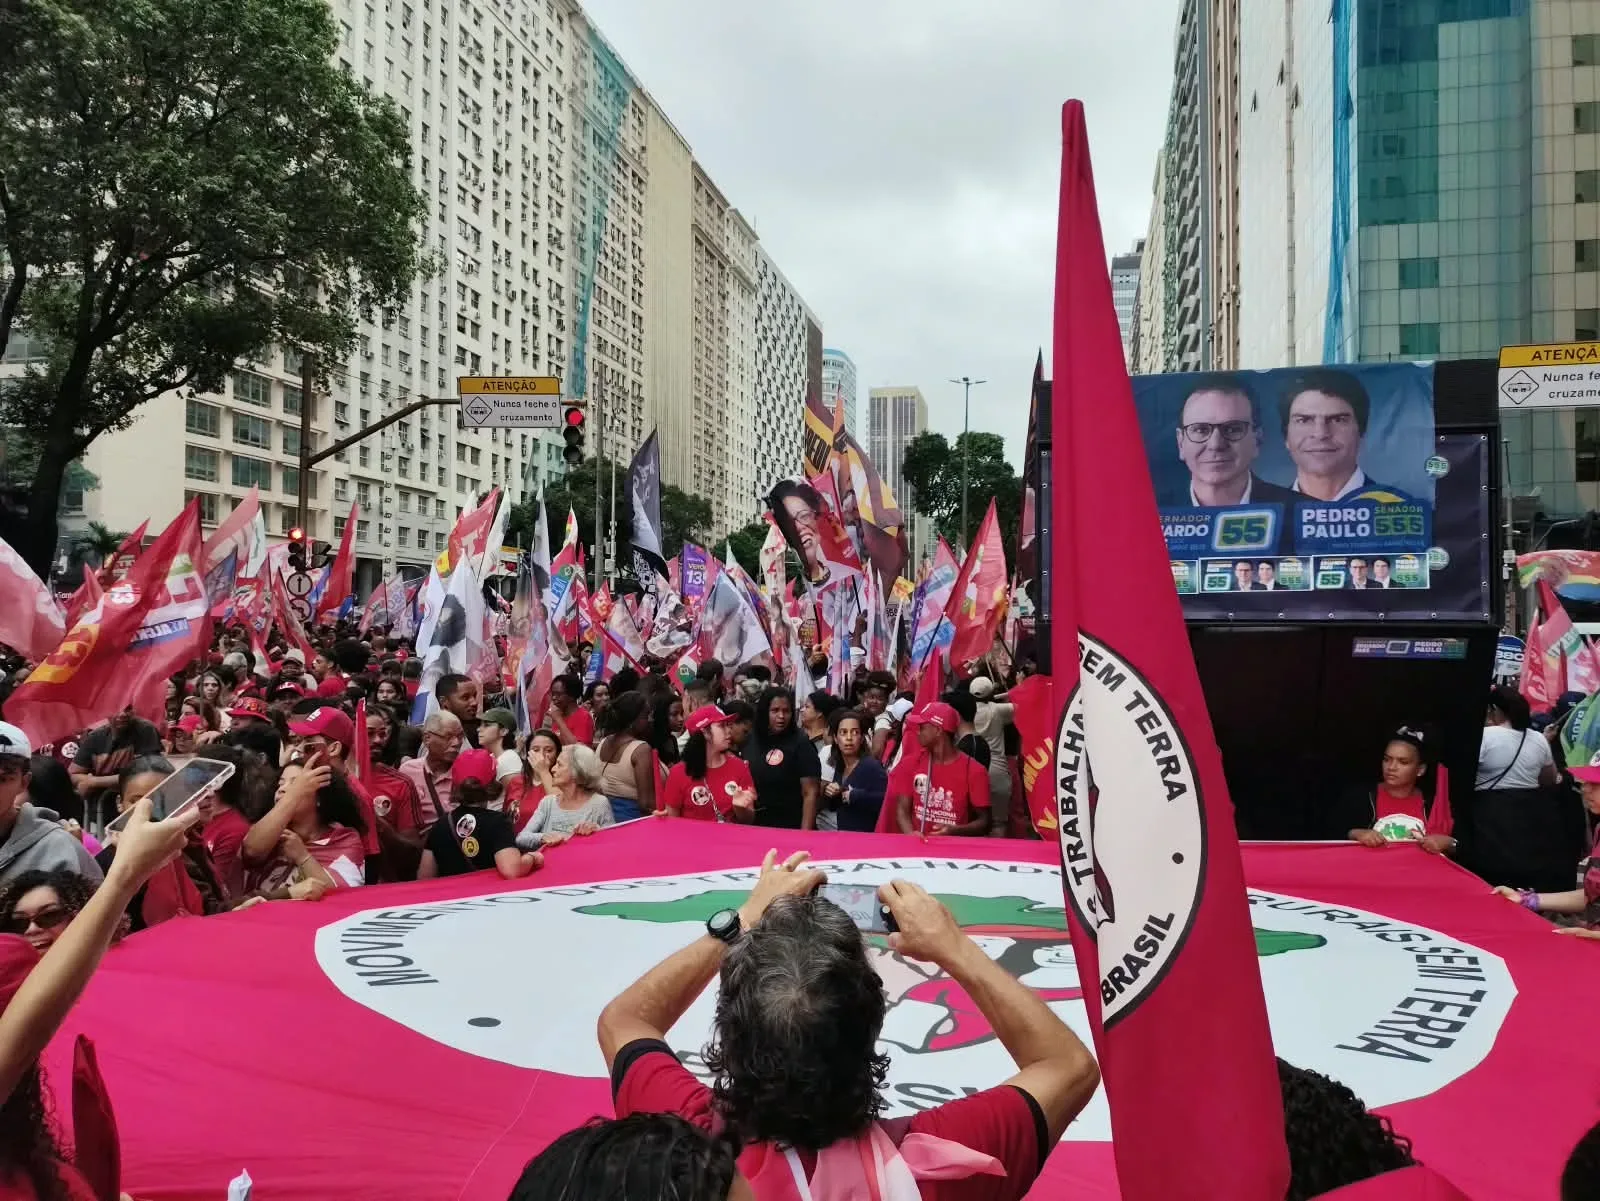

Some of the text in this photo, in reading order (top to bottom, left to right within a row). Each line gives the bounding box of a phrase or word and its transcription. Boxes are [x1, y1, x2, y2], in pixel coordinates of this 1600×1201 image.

[1543, 373, 1584, 382] Nunca
[482, 380, 537, 392] ATENÇÃO
[493, 399, 521, 408] Nunca
[524, 399, 548, 408] feche
[1302, 507, 1370, 522] PEDRO
[1375, 505, 1423, 514] SENADOR
[1161, 524, 1209, 537] ARDO
[1221, 517, 1268, 544] 55
[1302, 523, 1370, 538] PAULO
[1375, 516, 1423, 535] 555
[1207, 576, 1227, 587] 55
[1321, 573, 1341, 585] 55
[1125, 690, 1187, 803] TERRA
[1060, 698, 1094, 886] TRABALHA
[547, 880, 676, 897] DOS
[341, 896, 541, 987] MOVIMENTO
[1100, 912, 1175, 1006] BRASIL
[1403, 945, 1487, 982] SEM
[1334, 987, 1488, 1063] TERRA
